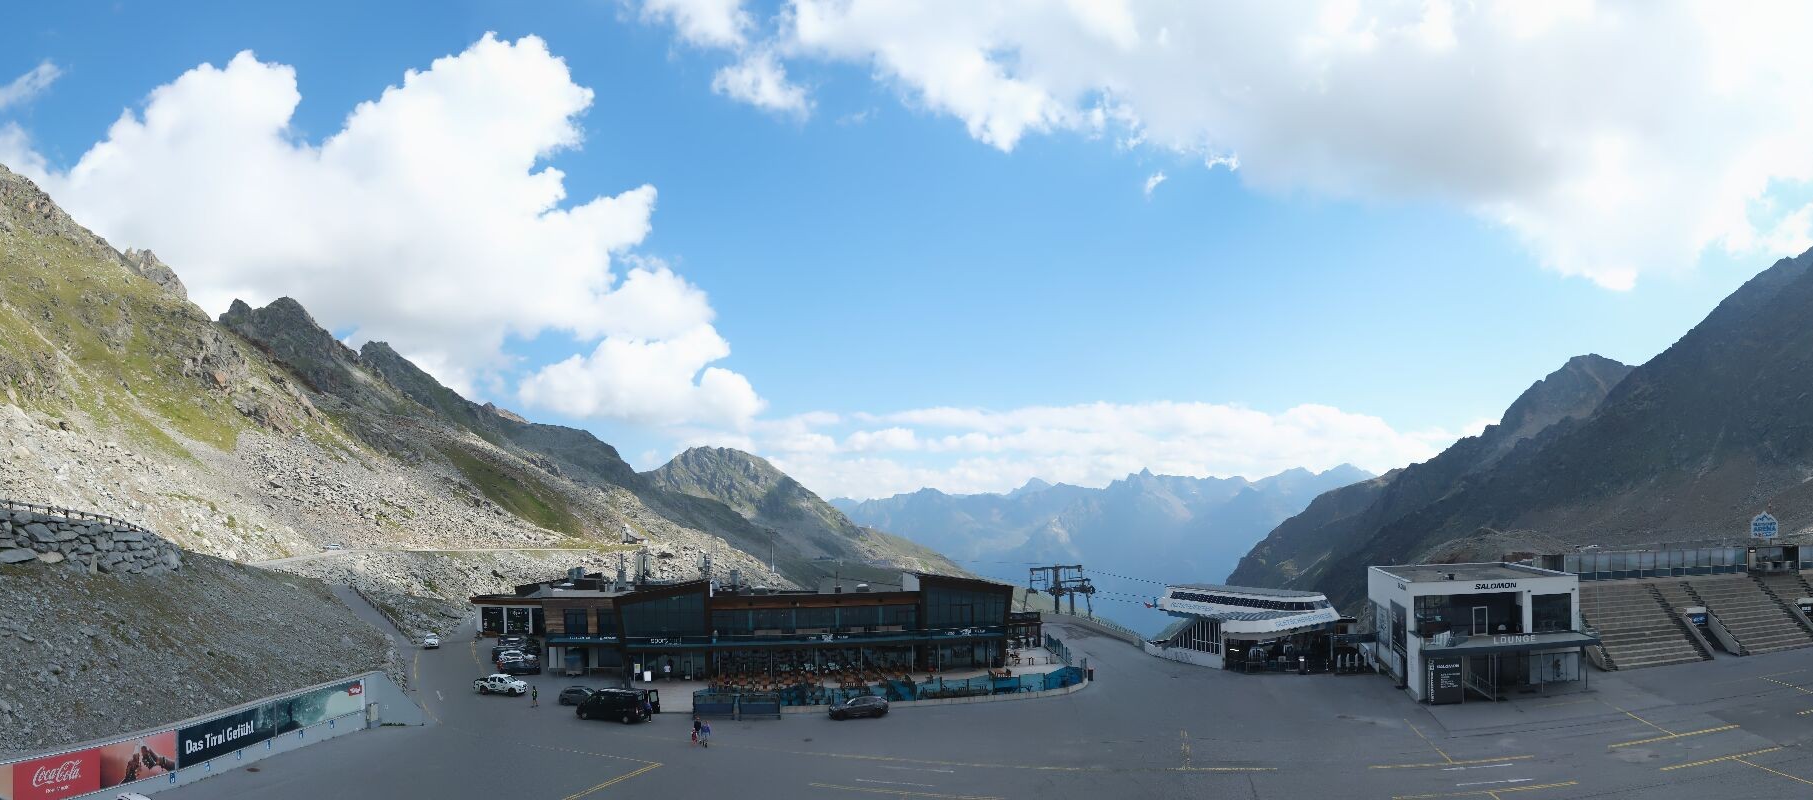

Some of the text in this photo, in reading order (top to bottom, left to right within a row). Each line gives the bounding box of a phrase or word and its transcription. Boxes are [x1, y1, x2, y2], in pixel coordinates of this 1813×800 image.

[1474, 582, 1517, 590] SALOMON
[1493, 634, 1537, 645] LOUNGE
[185, 720, 255, 755] Das Tirol Gefühl
